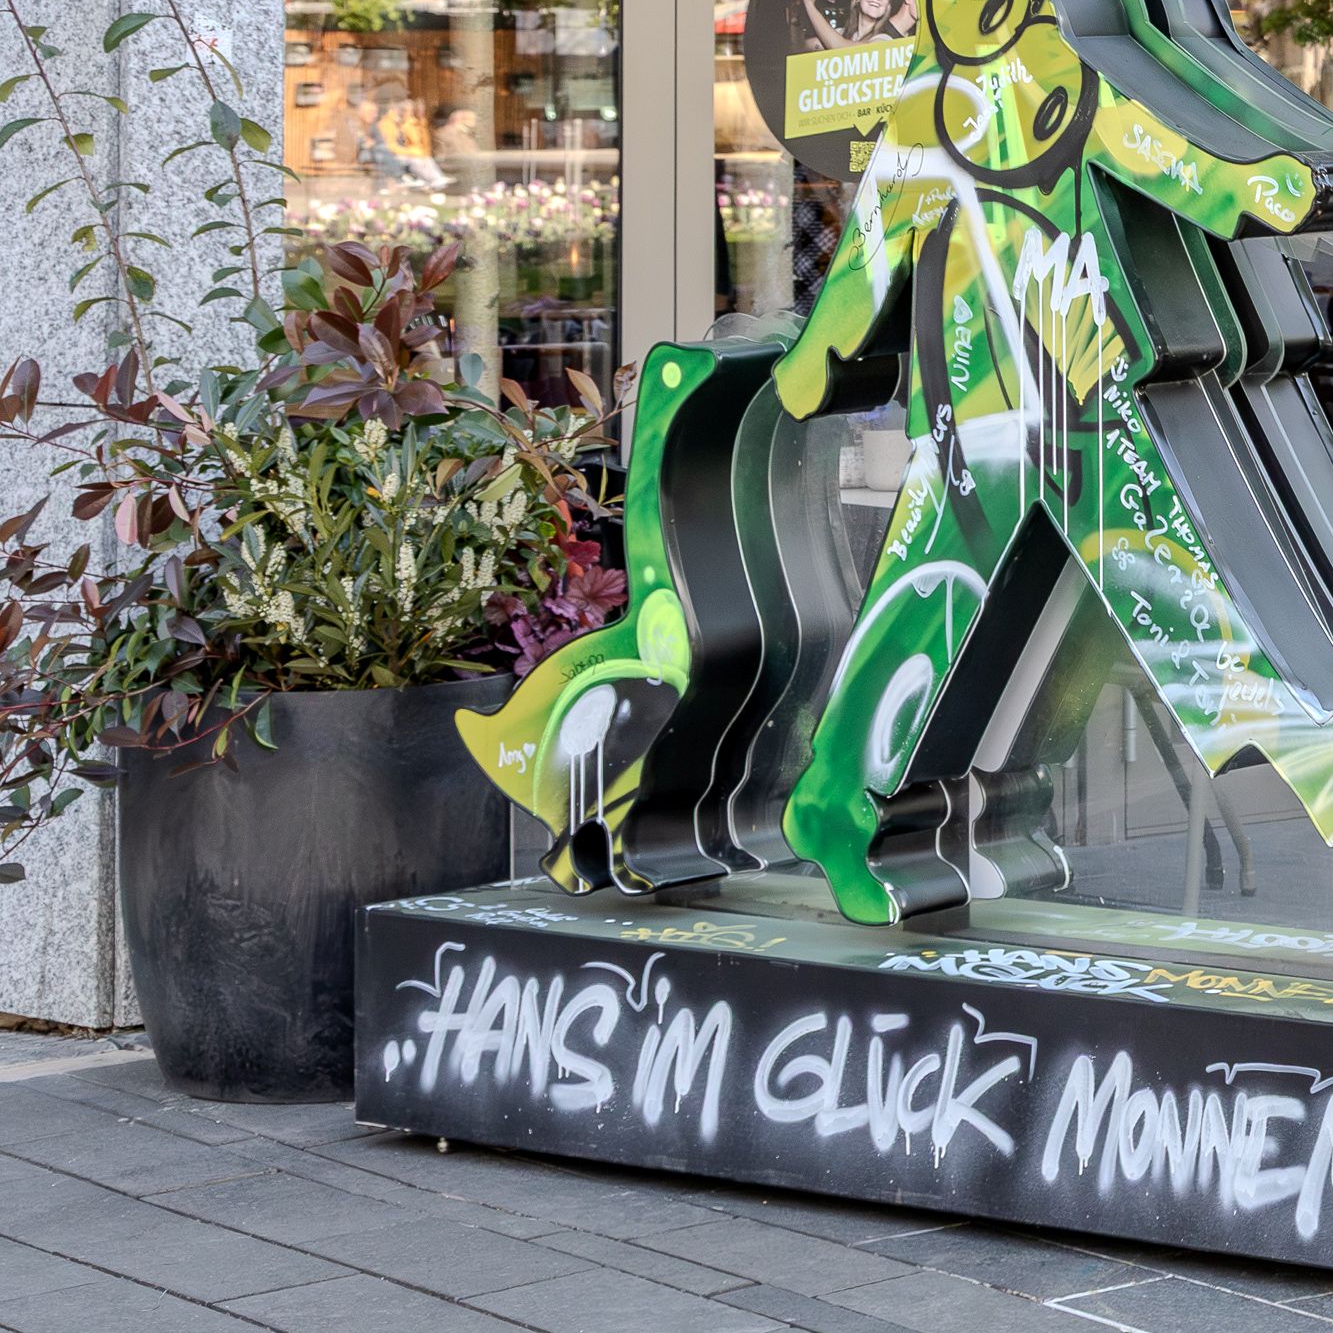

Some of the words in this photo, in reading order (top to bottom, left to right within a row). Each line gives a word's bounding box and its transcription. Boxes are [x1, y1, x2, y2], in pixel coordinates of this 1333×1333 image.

[815, 47, 879, 82] KOMM
[885, 44, 914, 70] INS
[857, 107, 872, 118] BAR
[876, 102, 895, 115] KÜC
[1246, 174, 1296, 223] Paco
[1012, 226, 1110, 327] MA
[951, 325, 974, 393] Nina
[1130, 590, 1175, 649] Toni
